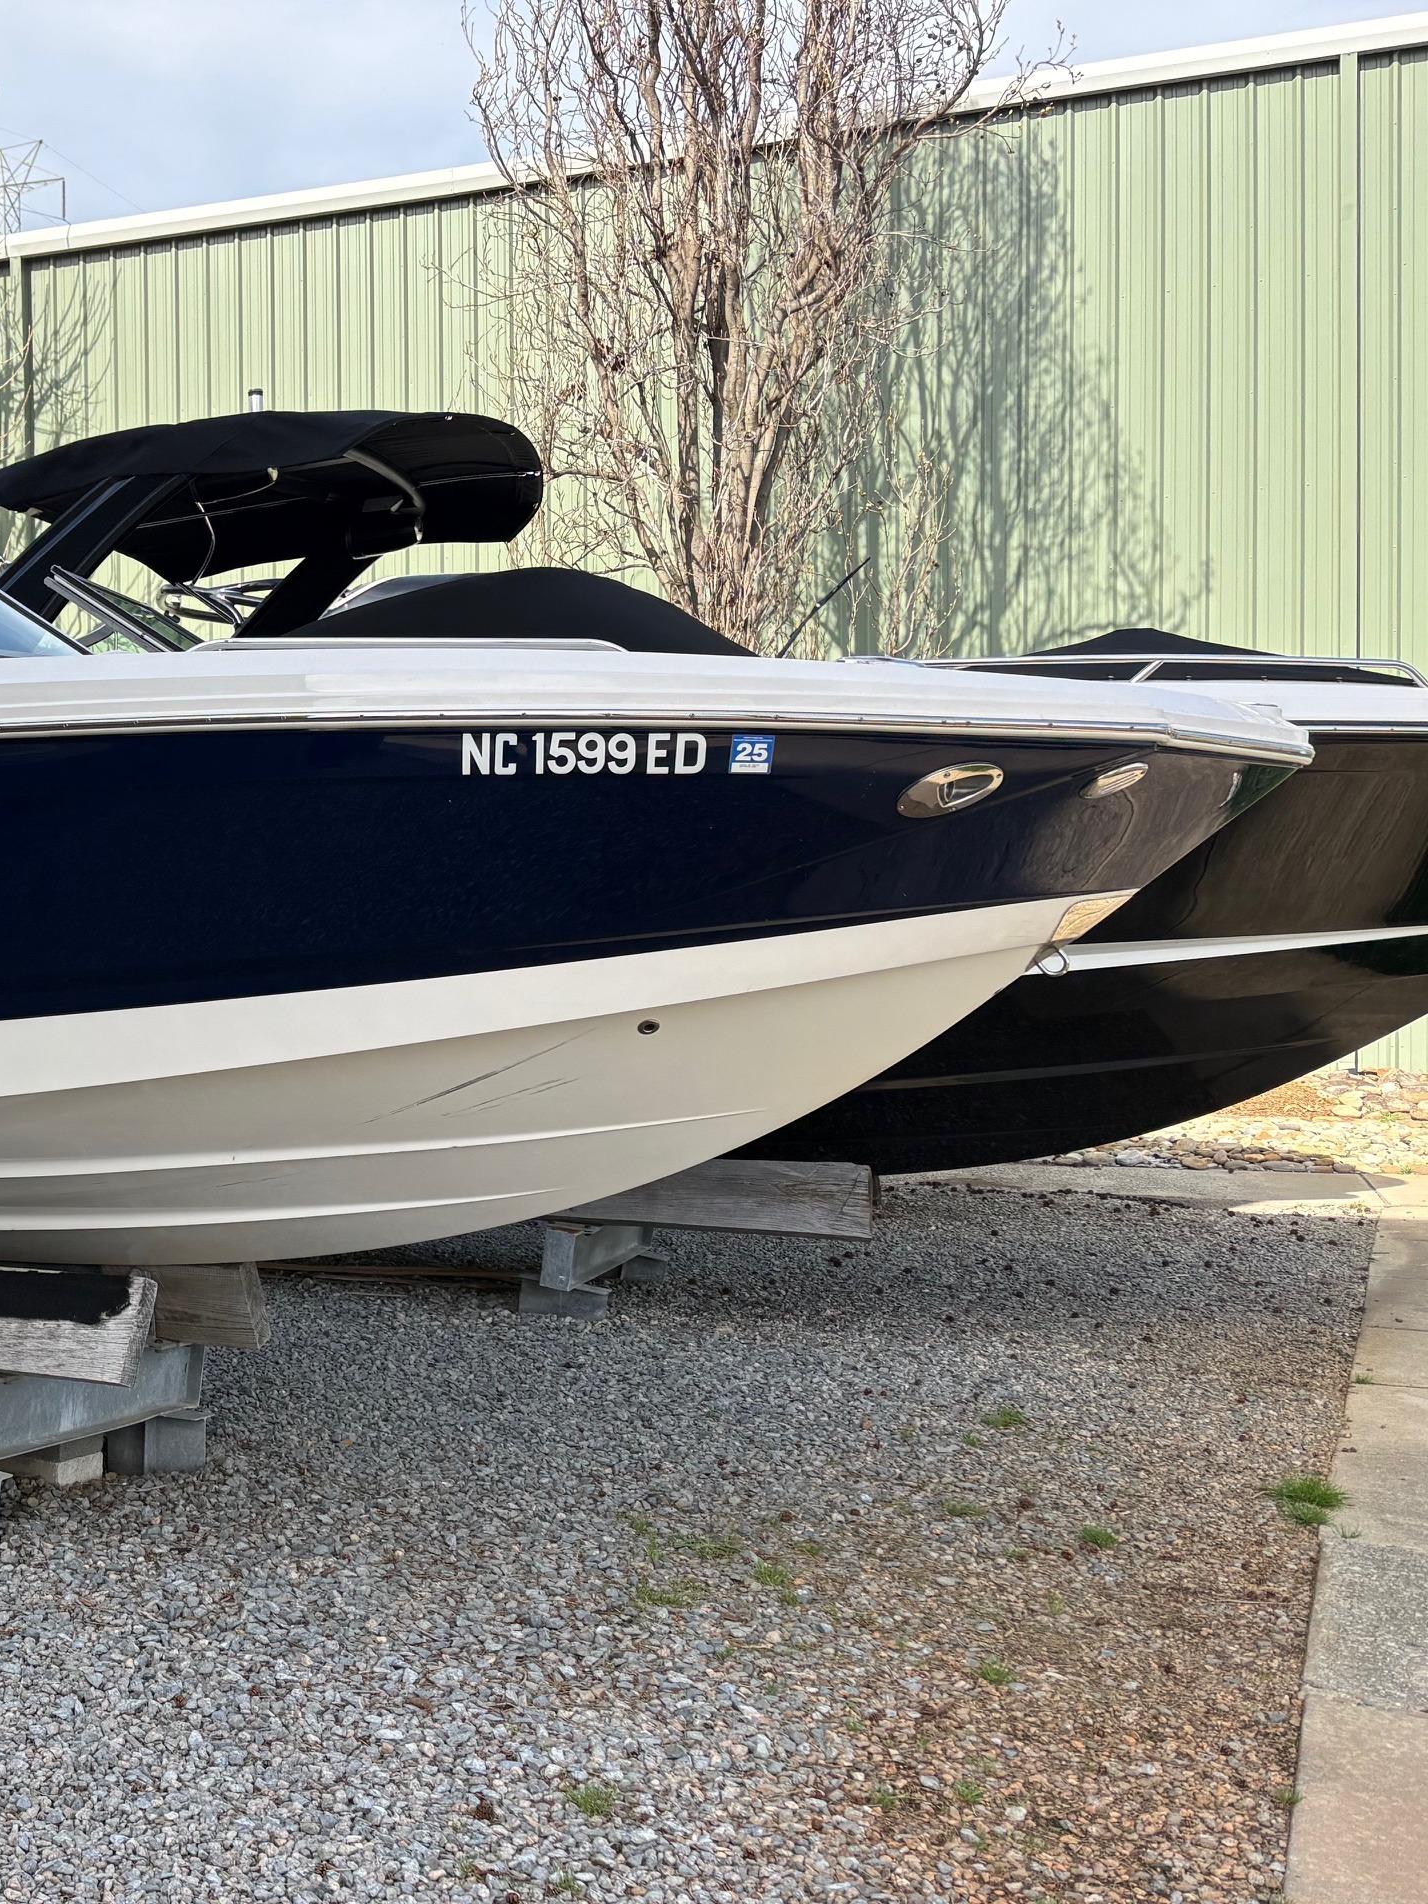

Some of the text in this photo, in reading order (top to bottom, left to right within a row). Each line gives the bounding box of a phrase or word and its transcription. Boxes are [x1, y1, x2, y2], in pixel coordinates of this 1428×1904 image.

[461, 732, 707, 775] NC 1599 ED
[735, 742, 768, 762] 25
